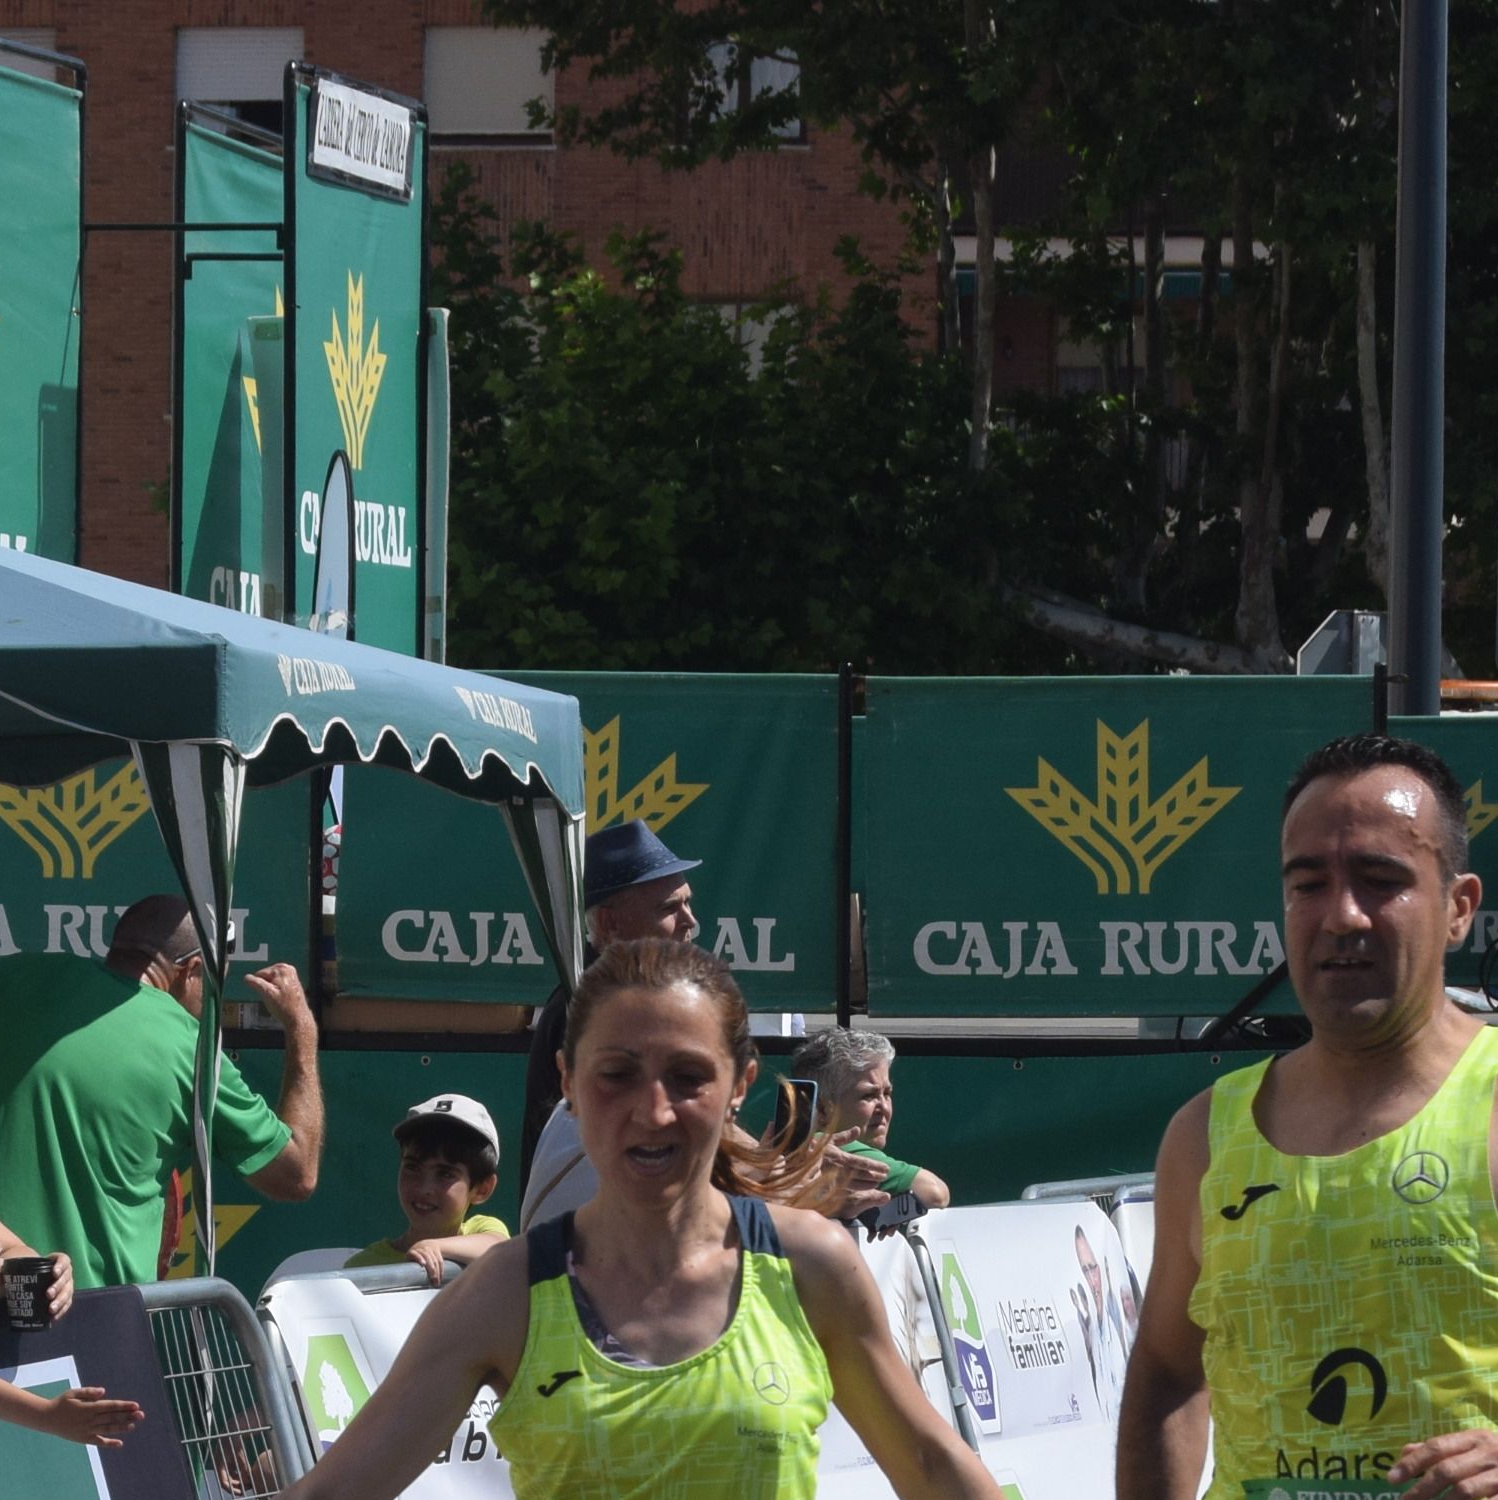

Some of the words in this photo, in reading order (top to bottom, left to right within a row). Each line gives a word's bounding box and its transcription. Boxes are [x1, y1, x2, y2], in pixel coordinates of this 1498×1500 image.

[43, 903, 268, 962] RUL
[381, 909, 544, 966] CAJA
[913, 920, 1079, 979] CAJA
[1099, 920, 1286, 975] RURA
[1370, 1234, 1470, 1250] Mercedes-Benz
[1397, 1254, 1443, 1267] Adarsa
[999, 1298, 1057, 1334] Medicina
[1009, 1334, 1066, 1370] familiar
[1276, 1446, 1395, 1480] Adars
